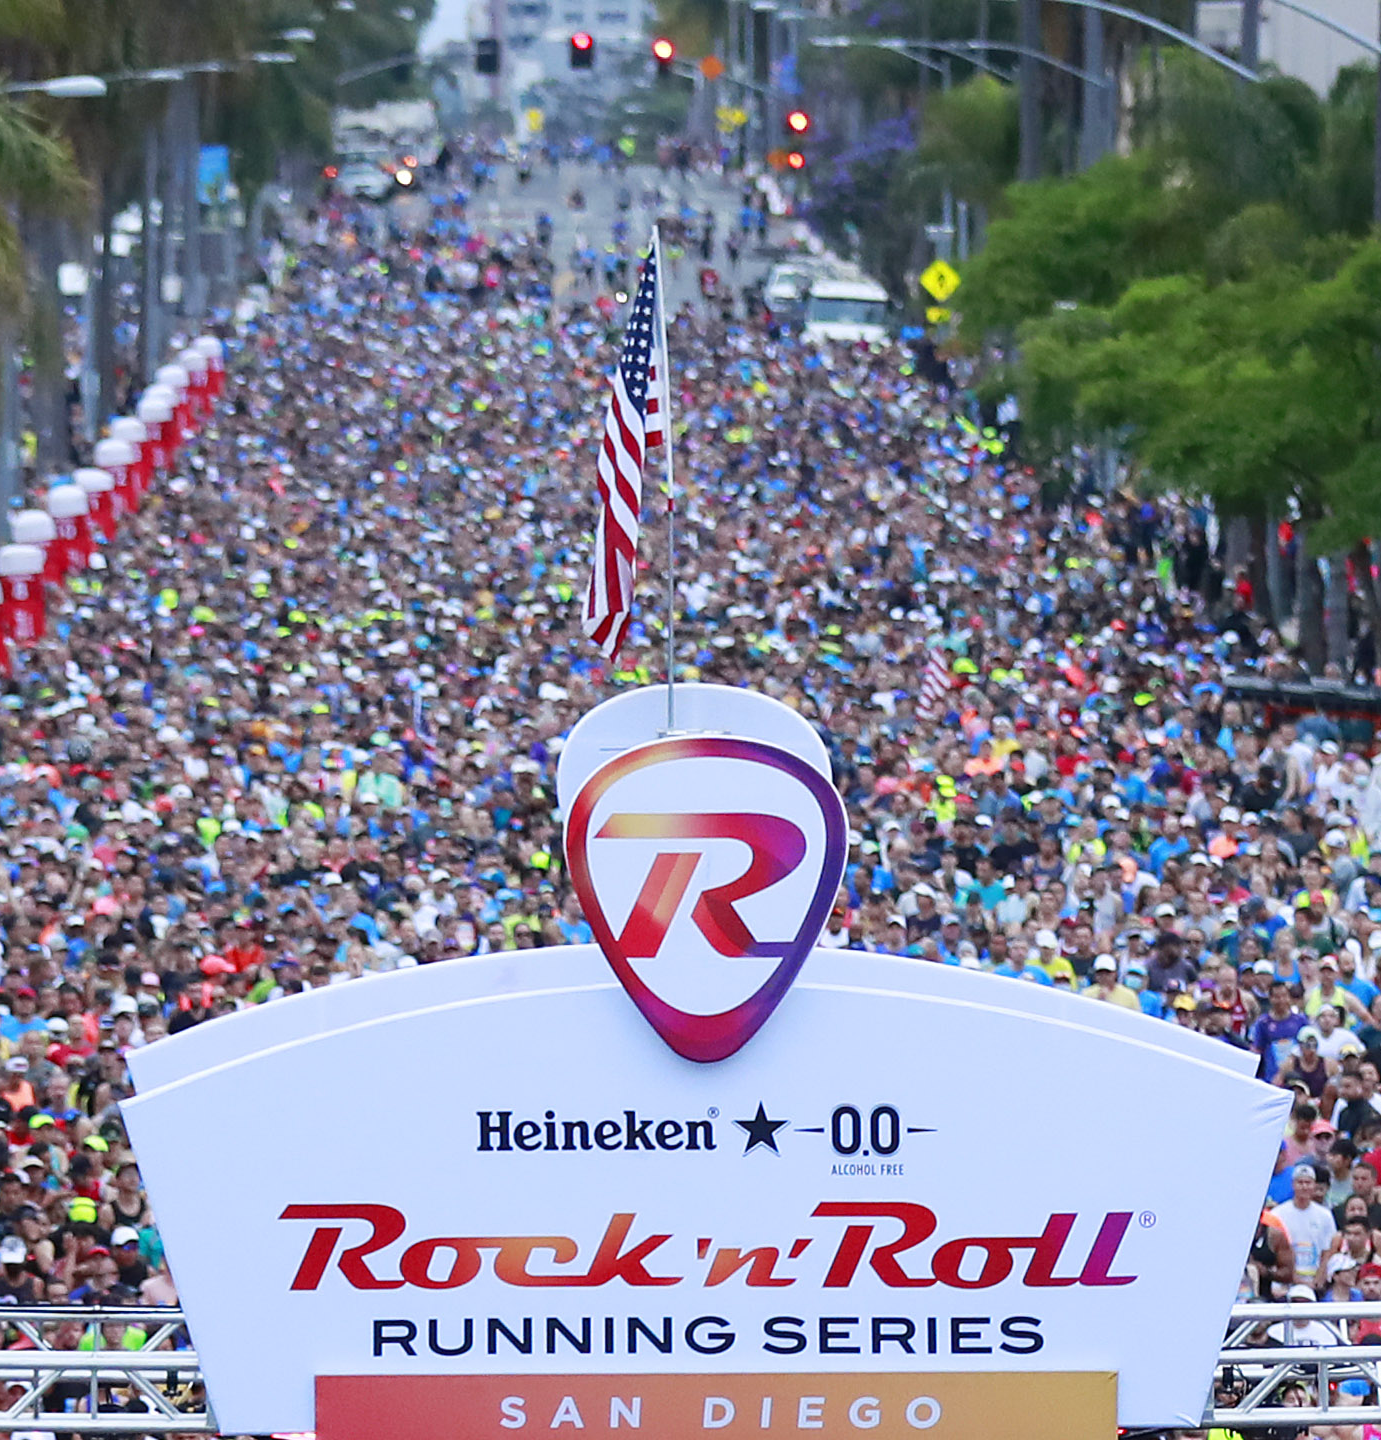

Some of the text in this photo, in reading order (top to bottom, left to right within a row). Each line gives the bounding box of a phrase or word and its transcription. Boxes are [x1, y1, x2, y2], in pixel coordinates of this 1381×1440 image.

[476, 1110, 717, 1152] Heineken
[830, 1163, 905, 1176] ALCOHOL FREE
[372, 1315, 1047, 1357] RUNNING SERIES
[499, 1394, 945, 1431] SAN DIEGO
